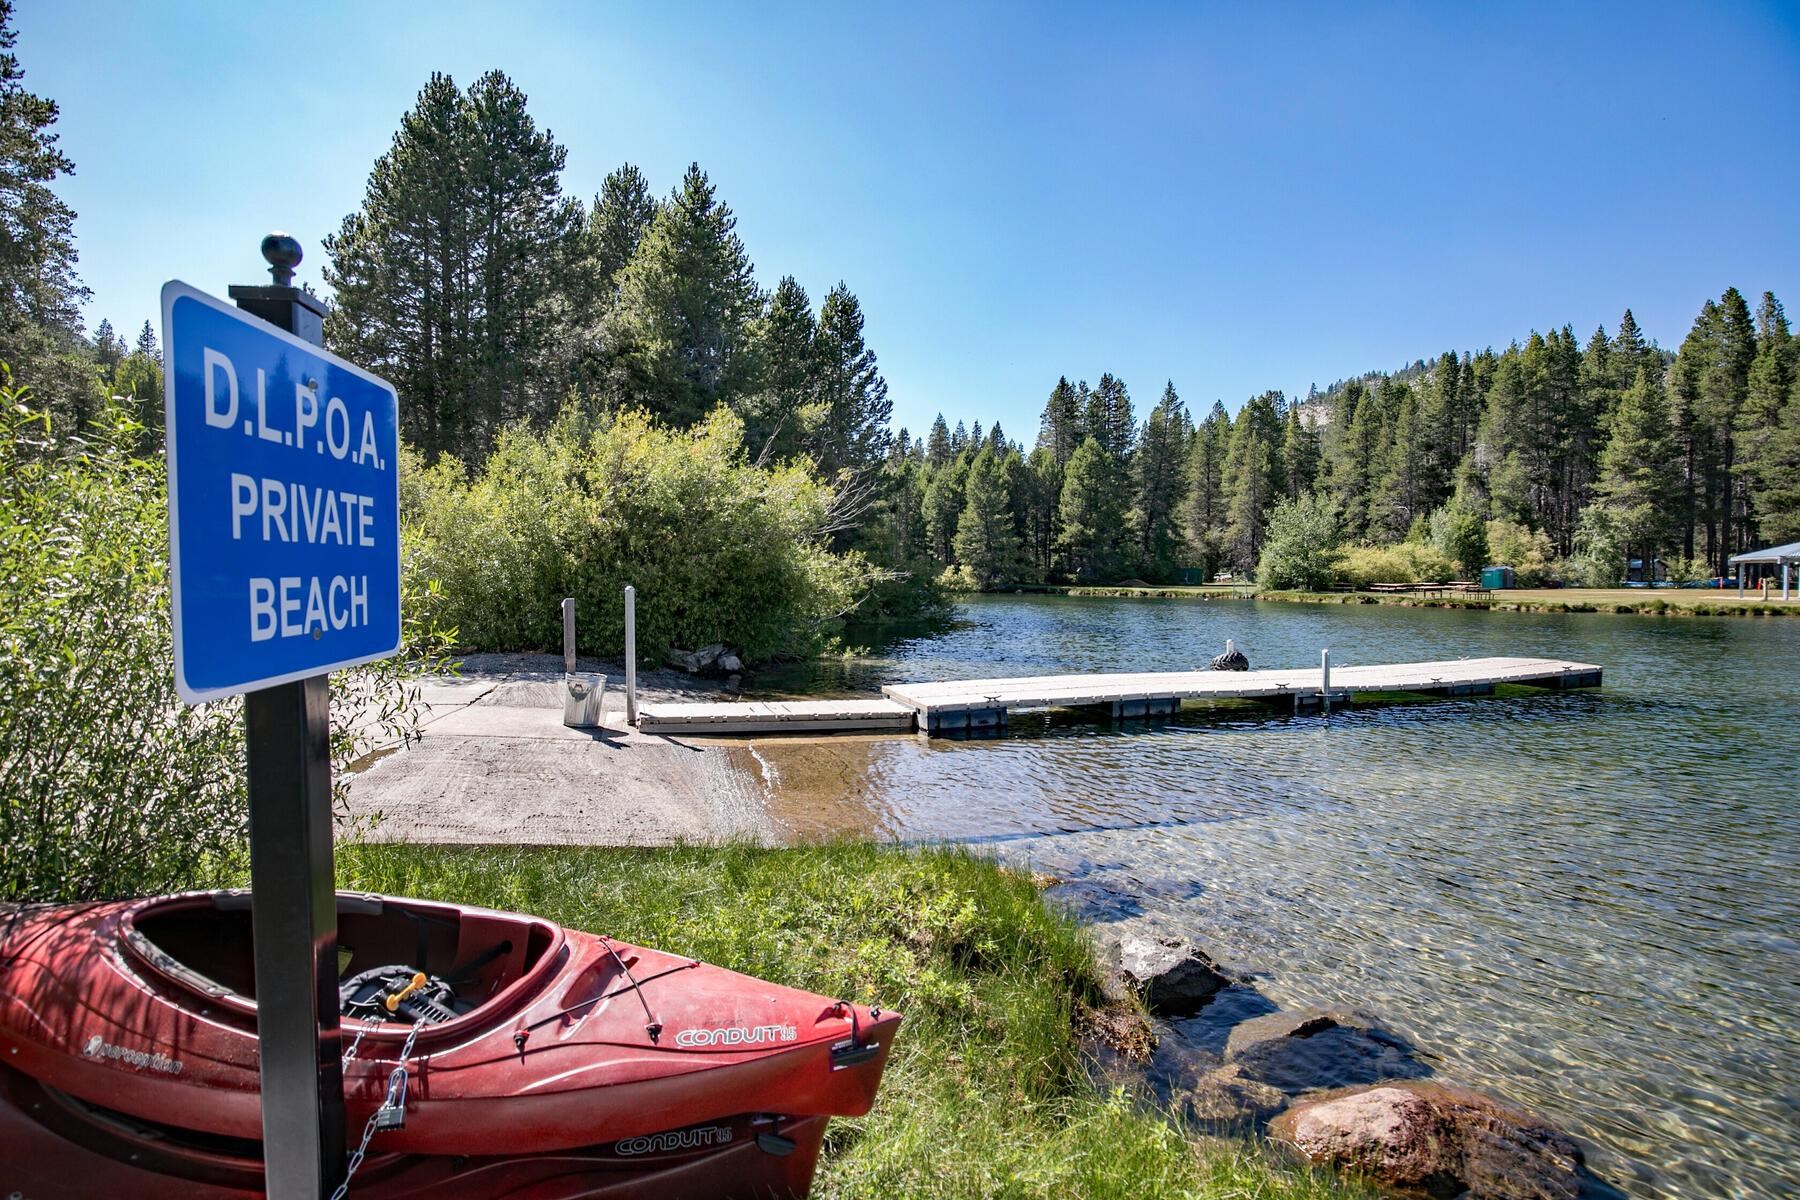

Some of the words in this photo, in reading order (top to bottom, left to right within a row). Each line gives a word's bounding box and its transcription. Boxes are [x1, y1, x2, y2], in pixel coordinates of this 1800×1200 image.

[203, 346, 386, 471] D.L.P.O.A.
[231, 472, 375, 547] PRIVATE
[249, 575, 369, 642] BEACH
[676, 1026, 780, 1046] CONDUIT
[615, 1126, 717, 1155] CONDUIT
